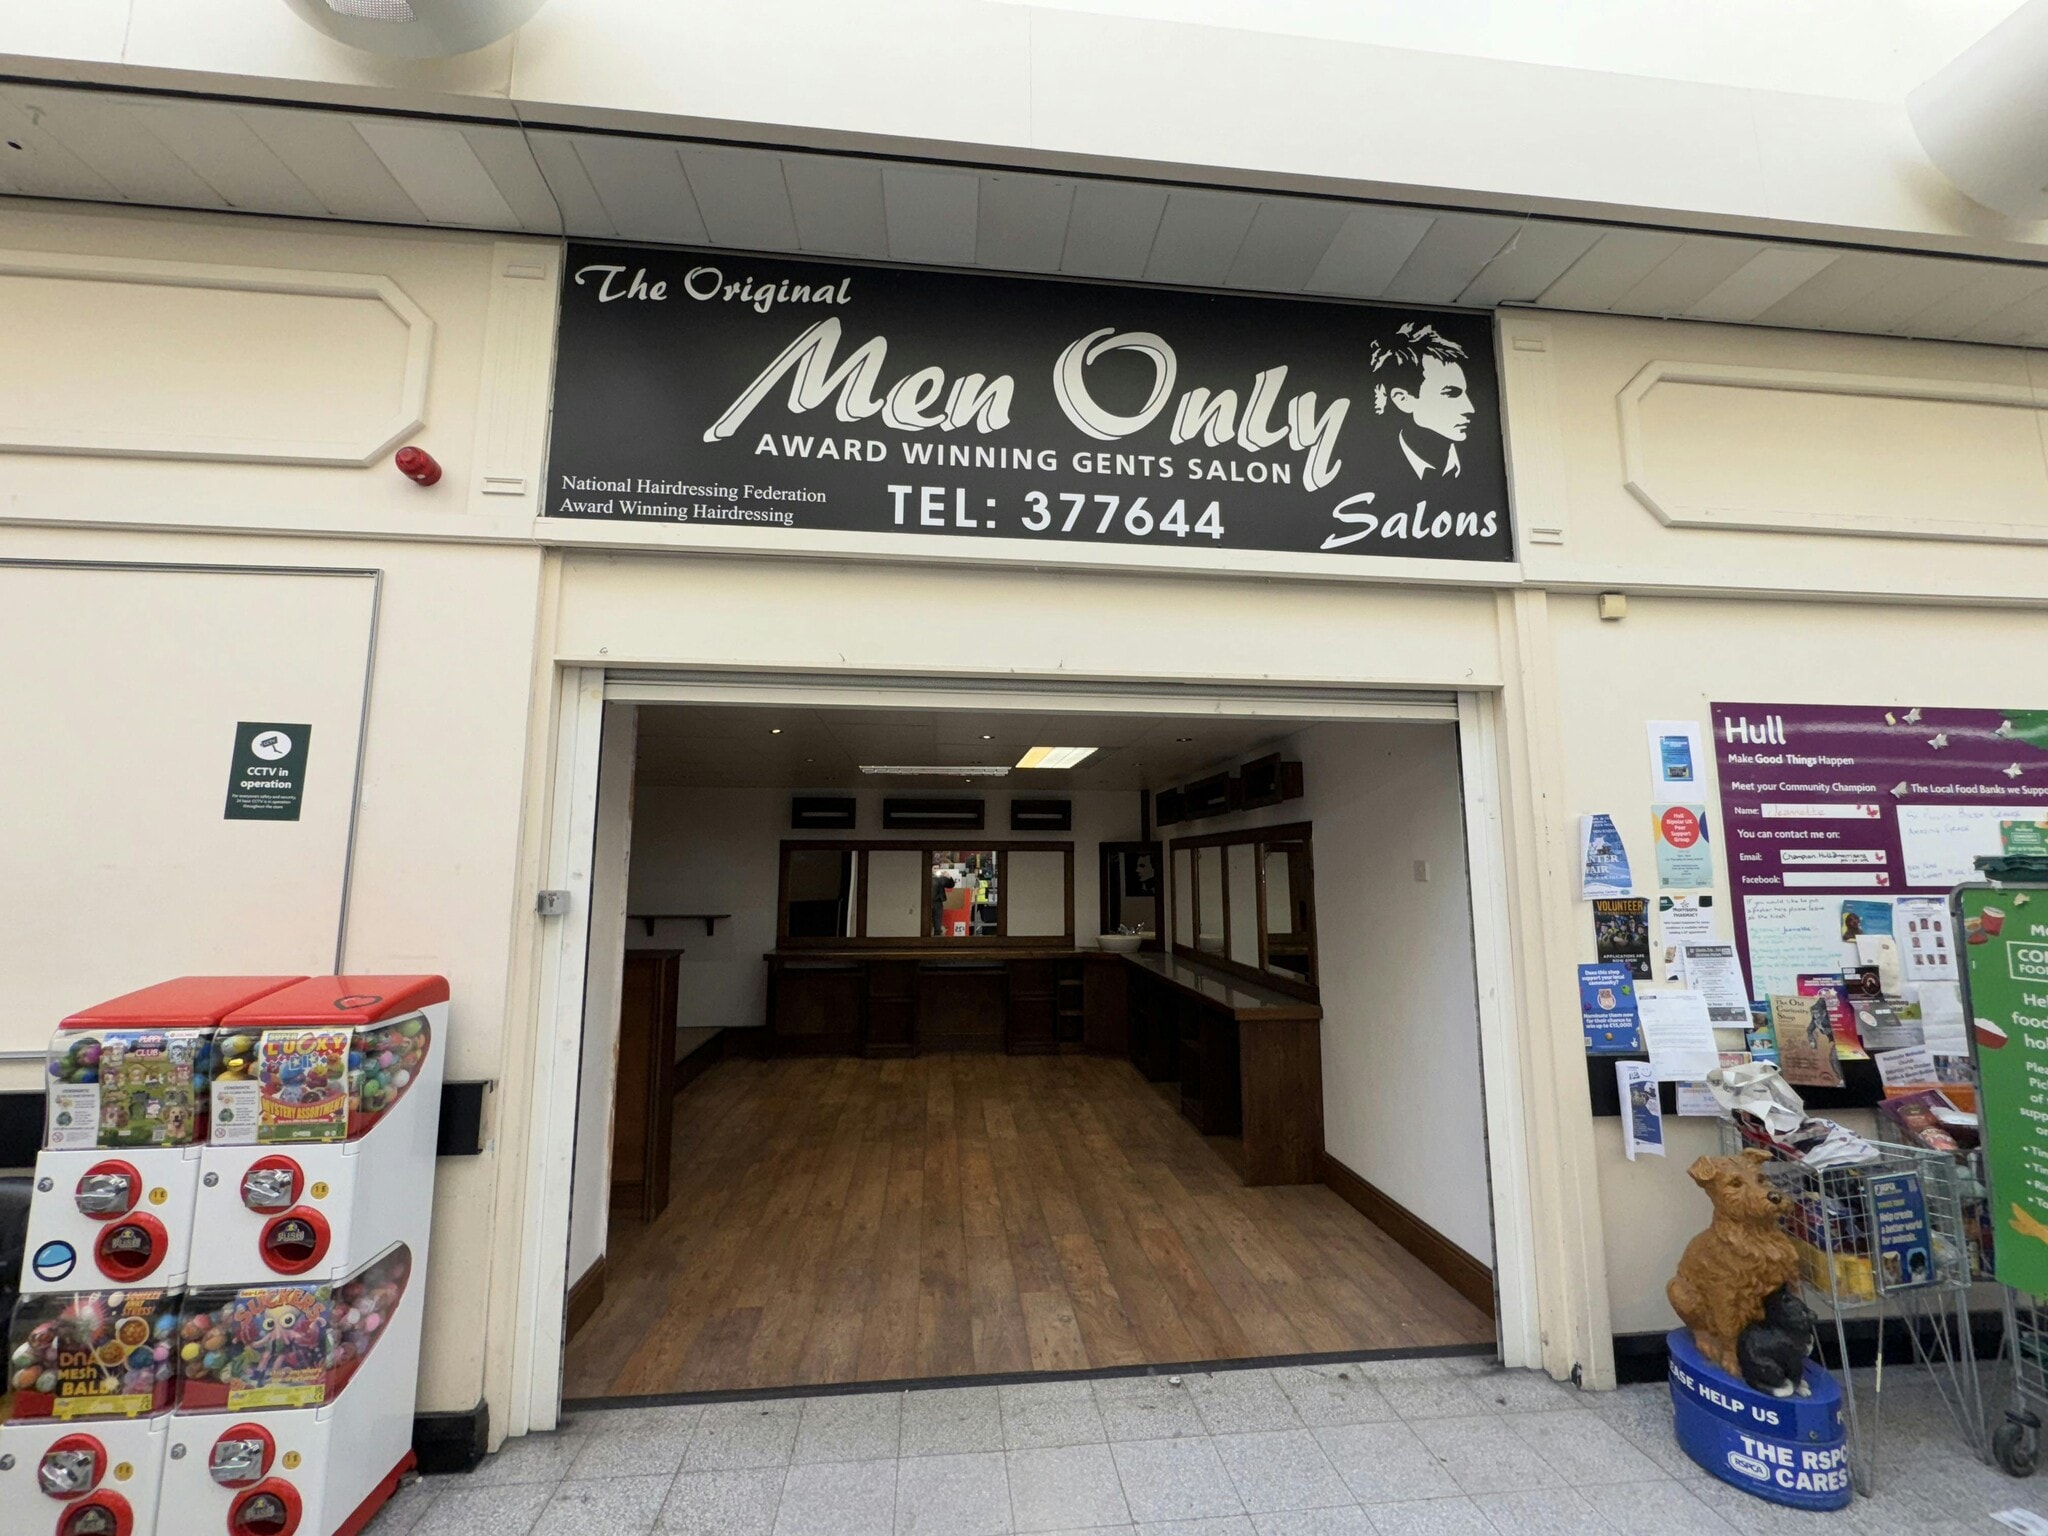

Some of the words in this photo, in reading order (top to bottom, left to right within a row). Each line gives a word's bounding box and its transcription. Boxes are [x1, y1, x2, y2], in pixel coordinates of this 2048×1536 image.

[574, 264, 667, 303] The
[684, 267, 851, 313] Original
[703, 316, 1014, 443] Men
[1053, 326, 1350, 492] Only
[755, 433, 887, 462] AWARD
[902, 442, 1057, 471] WINNING
[1072, 452, 1174, 478] GENTS
[1187, 459, 1291, 484] SALON
[562, 475, 631, 493] National
[637, 478, 738, 501] Hairdressing
[743, 484, 826, 503] Federation
[559, 498, 613, 514] Award
[619, 500, 687, 520] Winning
[692, 504, 794, 525] Hairdressing
[887, 485, 997, 529] TEL:
[1021, 490, 1225, 539] 377644
[1320, 492, 1498, 550] Salons
[1724, 715, 1786, 745] Hull
[1728, 753, 1753, 764] Make
[1755, 753, 1782, 764] Good
[1786, 753, 1817, 767] Things
[1818, 755, 1854, 767] Happen
[247, 766, 277, 776] CCTV
[279, 767, 289, 777] in
[240, 780, 292, 790] operation
[1732, 781, 1755, 792] Meet
[1757, 783, 1777, 795] your
[1779, 782, 1830, 795] Community
[1831, 783, 1876, 795] Champion
[1911, 783, 1928, 793] The
[1930, 784, 1954, 794] Local
[1955, 784, 1978, 794] Food
[1980, 785, 2005, 794] Banks
[1734, 806, 1759, 815] Name:
[1737, 829, 1755, 839] You
[1757, 831, 1772, 839] can
[1775, 830, 1808, 839] contact
[1739, 853, 1762, 861] Email:
[1742, 876, 1780, 884] Facebook:
[1597, 900, 1644, 911] VOLUNTEER
[1789, 998, 1804, 1006] Old
[267, 1032, 346, 1056] LUCKY
[135, 1049, 159, 1057] CLUB
[2030, 1094, 2044, 1103] of
[1880, 1212, 1893, 1222] Help
[1894, 1210, 1914, 1220] create
[1885, 1223, 1904, 1233] better
[1905, 1219, 1923, 1230] world
[1882, 1235, 1891, 1245] for
[234, 1288, 326, 1324] SUCKERS
[1699, 1383, 1745, 1413] HELP
[1752, 1406, 1779, 1425] US
[1740, 1435, 1795, 1467] THE
[1734, 1458, 1764, 1475] RSPCA
[1775, 1469, 1848, 1492] CARES
